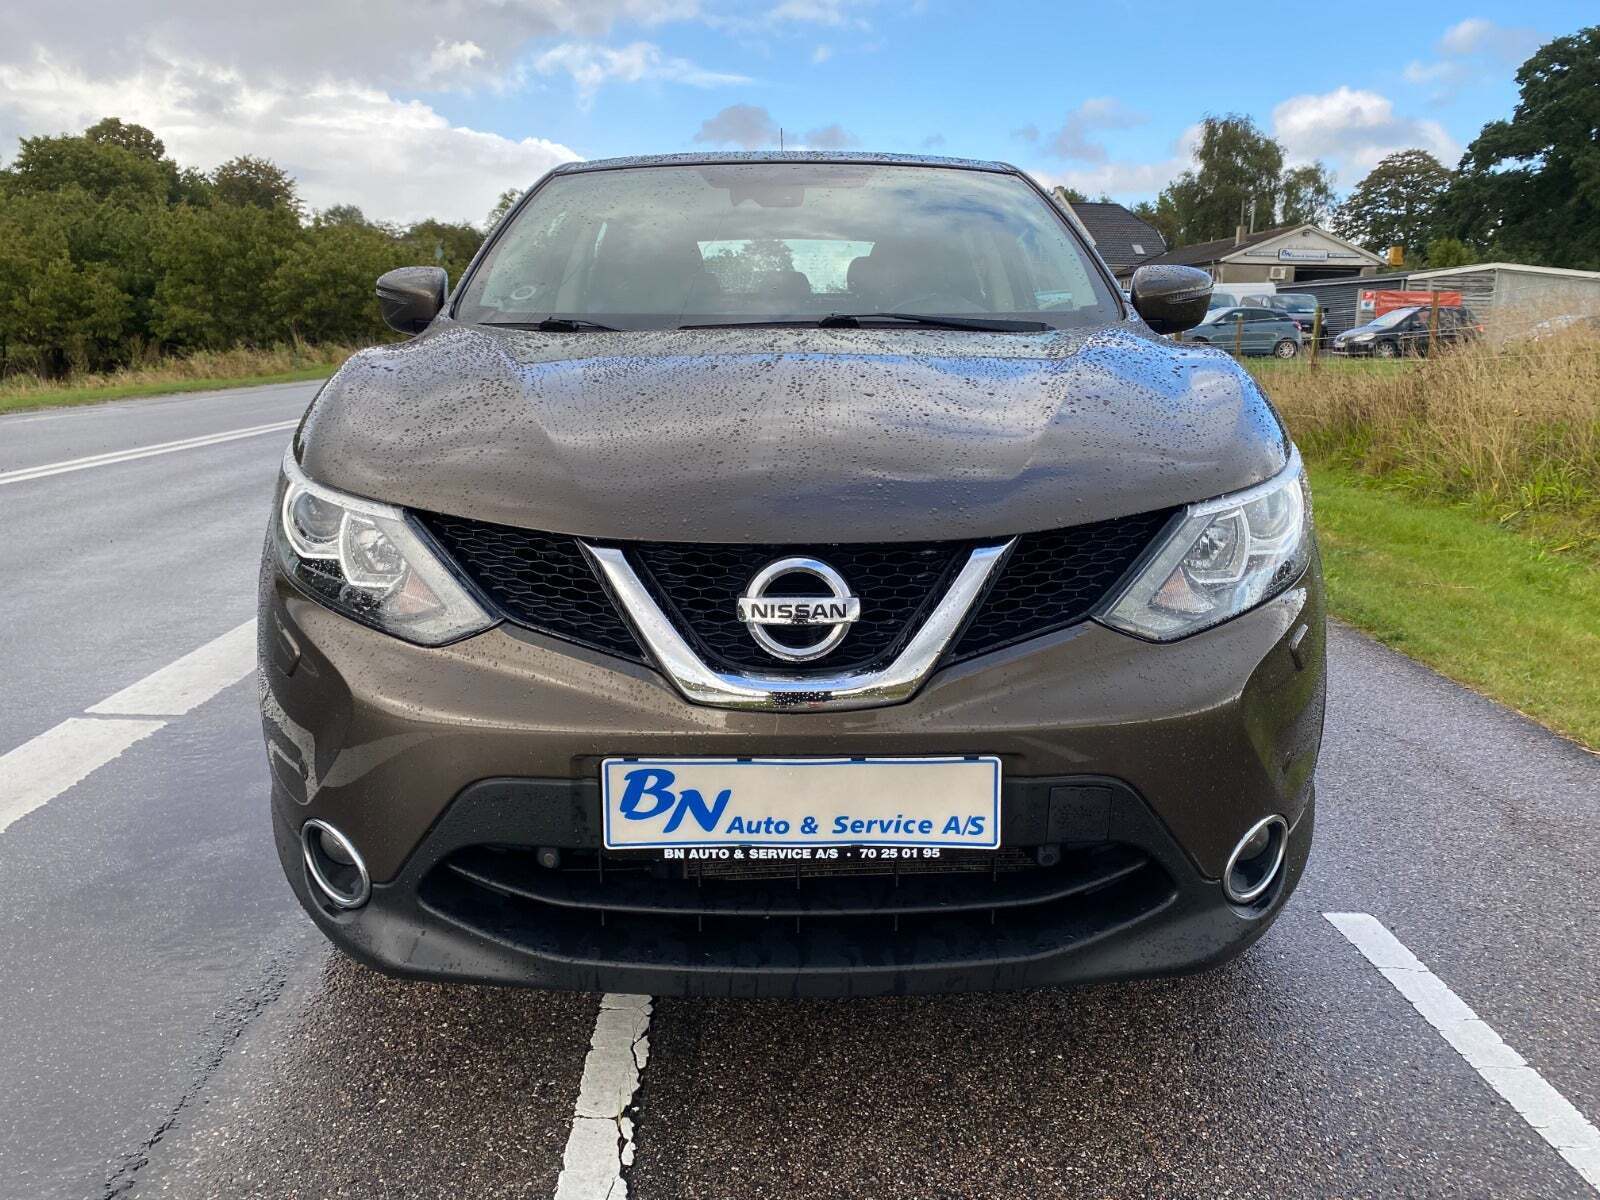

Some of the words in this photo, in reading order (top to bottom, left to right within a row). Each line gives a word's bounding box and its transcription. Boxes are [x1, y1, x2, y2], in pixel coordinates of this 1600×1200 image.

[750, 603, 847, 619] NISSAN
[619, 767, 732, 834] BN
[726, 815, 790, 835] Auto
[799, 816, 819, 836] &
[832, 815, 934, 835] Service
[942, 815, 985, 836] A/S
[663, 848, 685, 859] BN
[688, 848, 730, 859] AUTO
[733, 848, 745, 859] &
[748, 848, 812, 859] SERVICE
[815, 848, 839, 859] A/S
[859, 848, 877, 858] 70
[880, 848, 899, 858] 25
[901, 847, 918, 858] 01
[922, 847, 941, 857] 95
